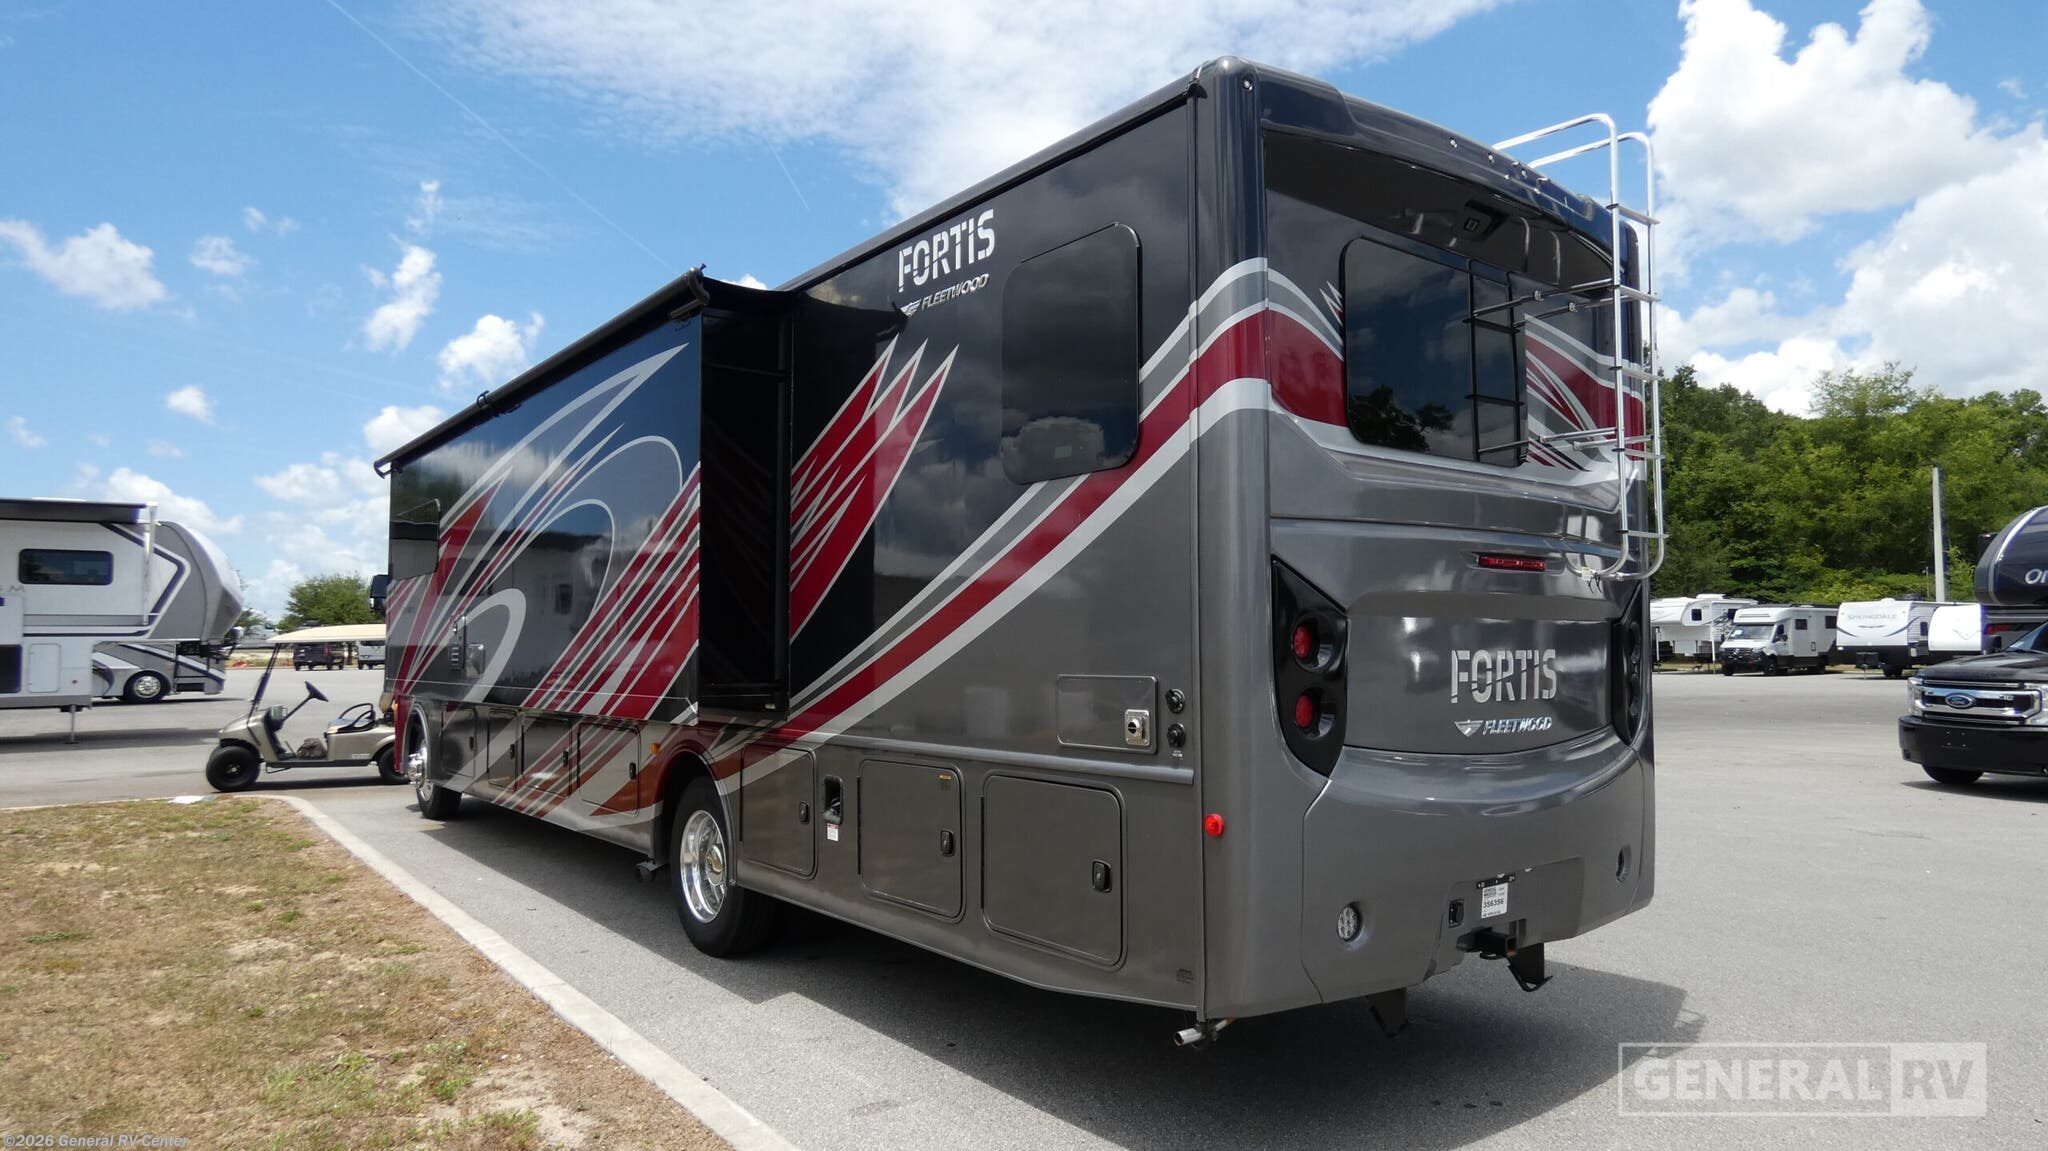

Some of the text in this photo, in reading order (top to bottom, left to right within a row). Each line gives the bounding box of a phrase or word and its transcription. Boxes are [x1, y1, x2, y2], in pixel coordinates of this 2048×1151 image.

[898, 209, 996, 293] FORTIS
[921, 273, 990, 310] FLEETWOOD
[1451, 649, 1557, 703] FORTIS
[1483, 717, 1553, 735] FLEETWOOD
